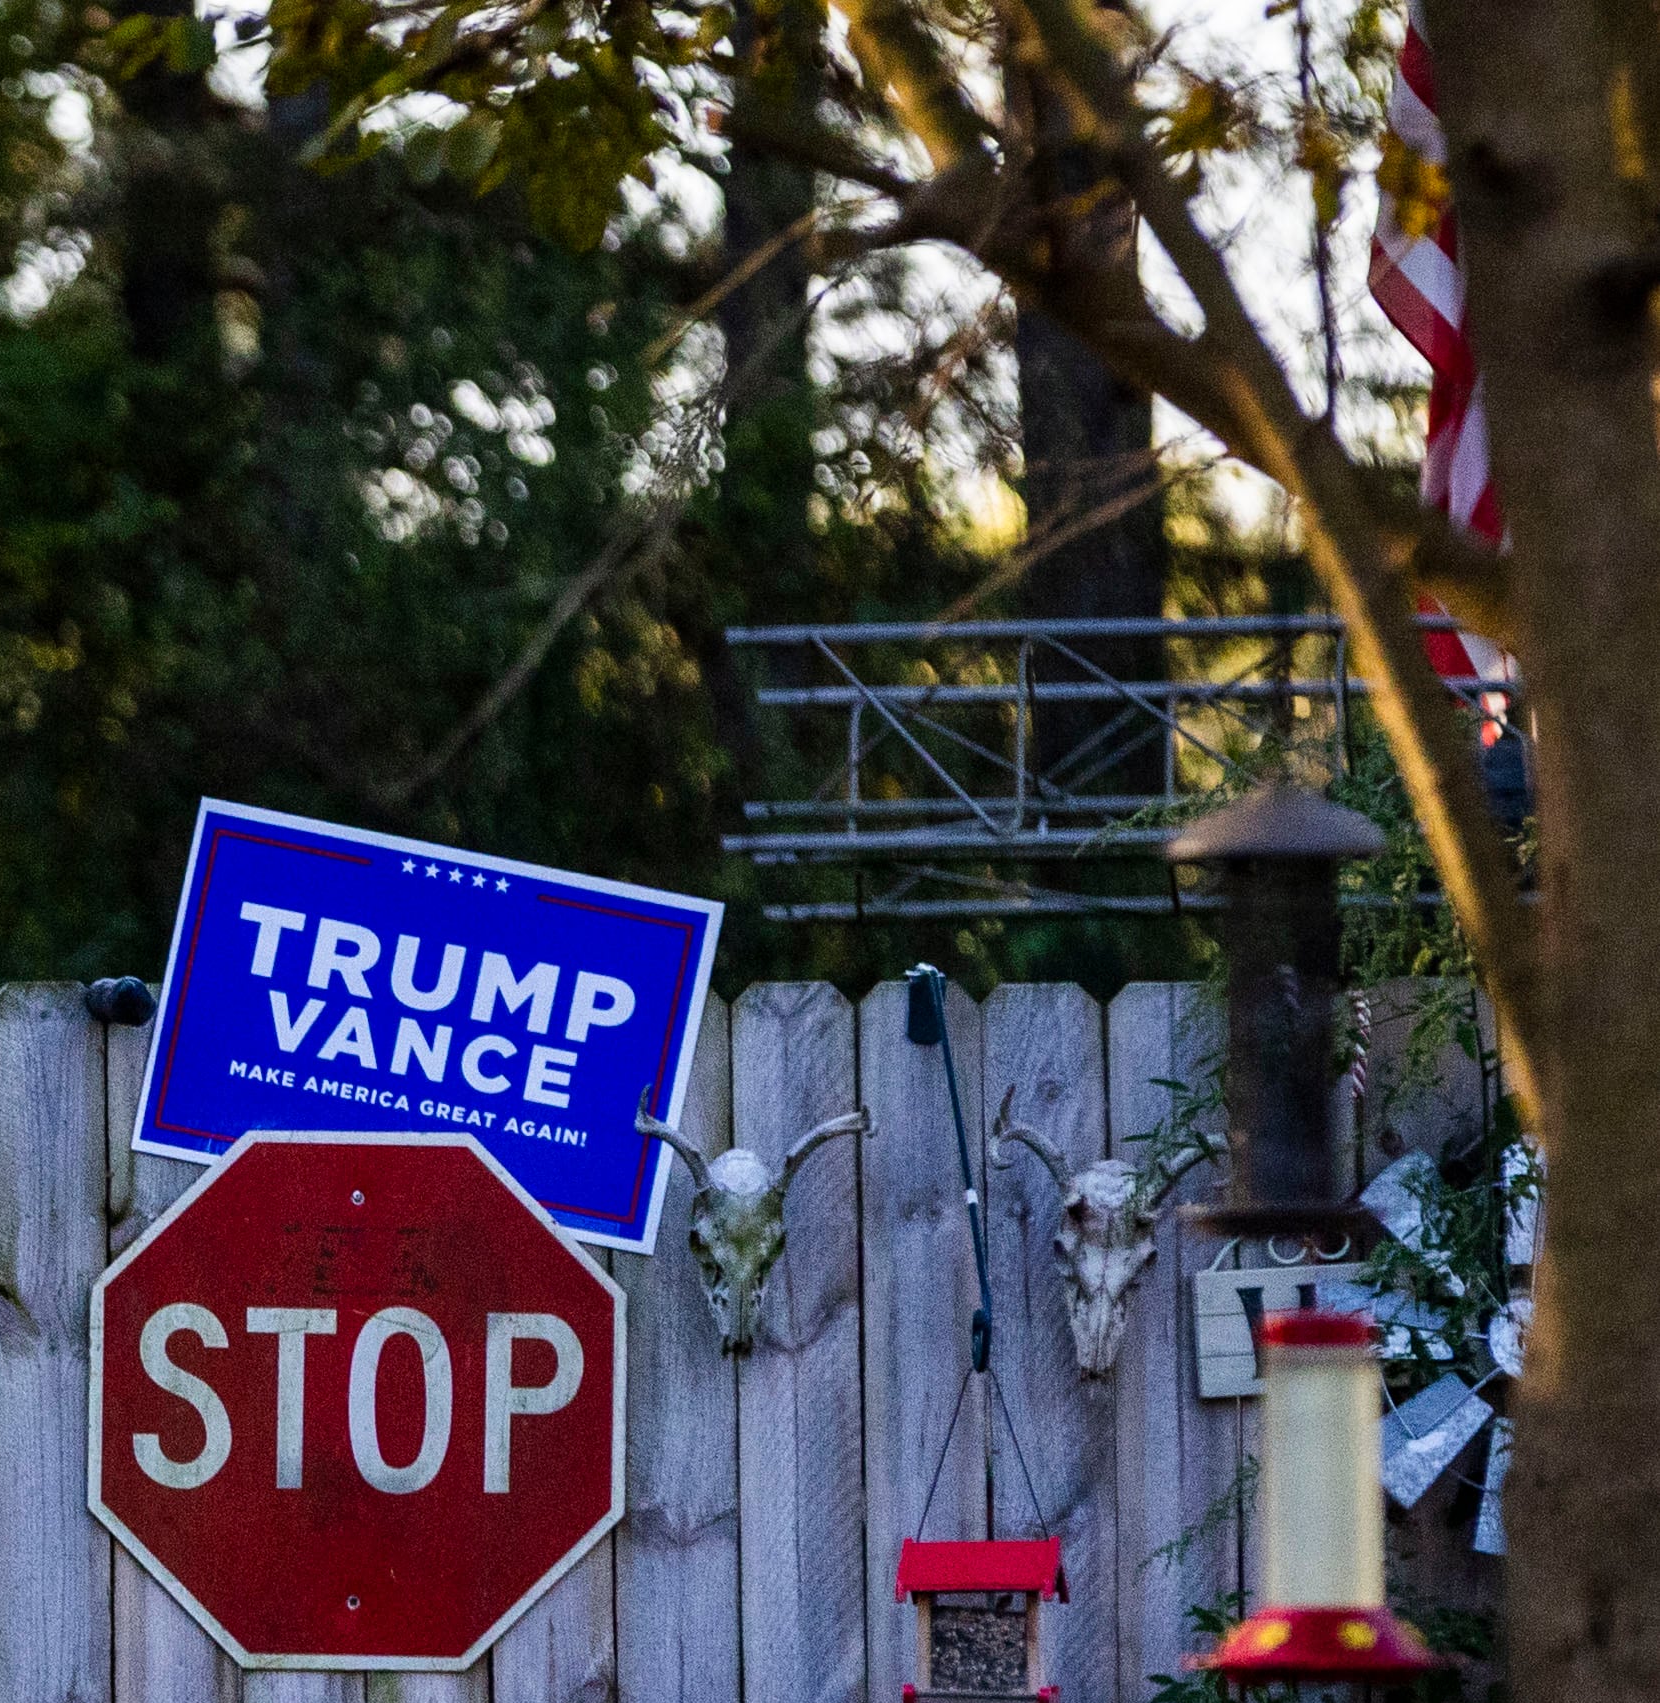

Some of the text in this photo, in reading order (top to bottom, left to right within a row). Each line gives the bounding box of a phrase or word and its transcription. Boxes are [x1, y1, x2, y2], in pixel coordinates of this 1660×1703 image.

[239, 900, 637, 1043] TRUMP
[229, 1059, 588, 1148] MAKE AMERICA GREAT AGAIN!
[268, 989, 579, 1109] VANCE
[132, 1301, 585, 1495] STOP
